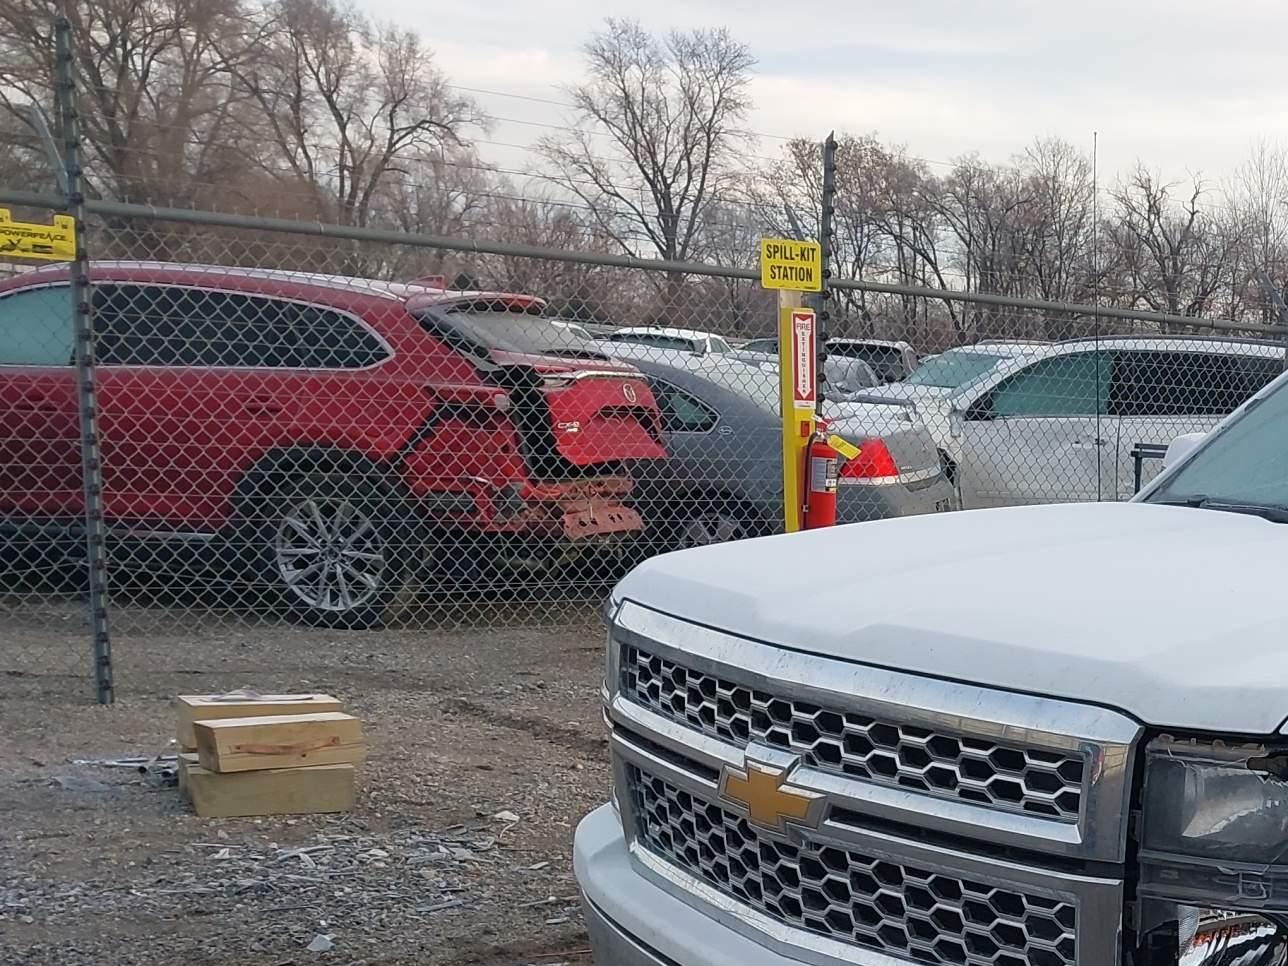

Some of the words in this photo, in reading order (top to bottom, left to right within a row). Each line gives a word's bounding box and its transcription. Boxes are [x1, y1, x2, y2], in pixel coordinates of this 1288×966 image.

[766, 244, 817, 263] SPILL-KIT
[770, 264, 813, 282] STATION
[796, 321, 811, 331] FIRE
